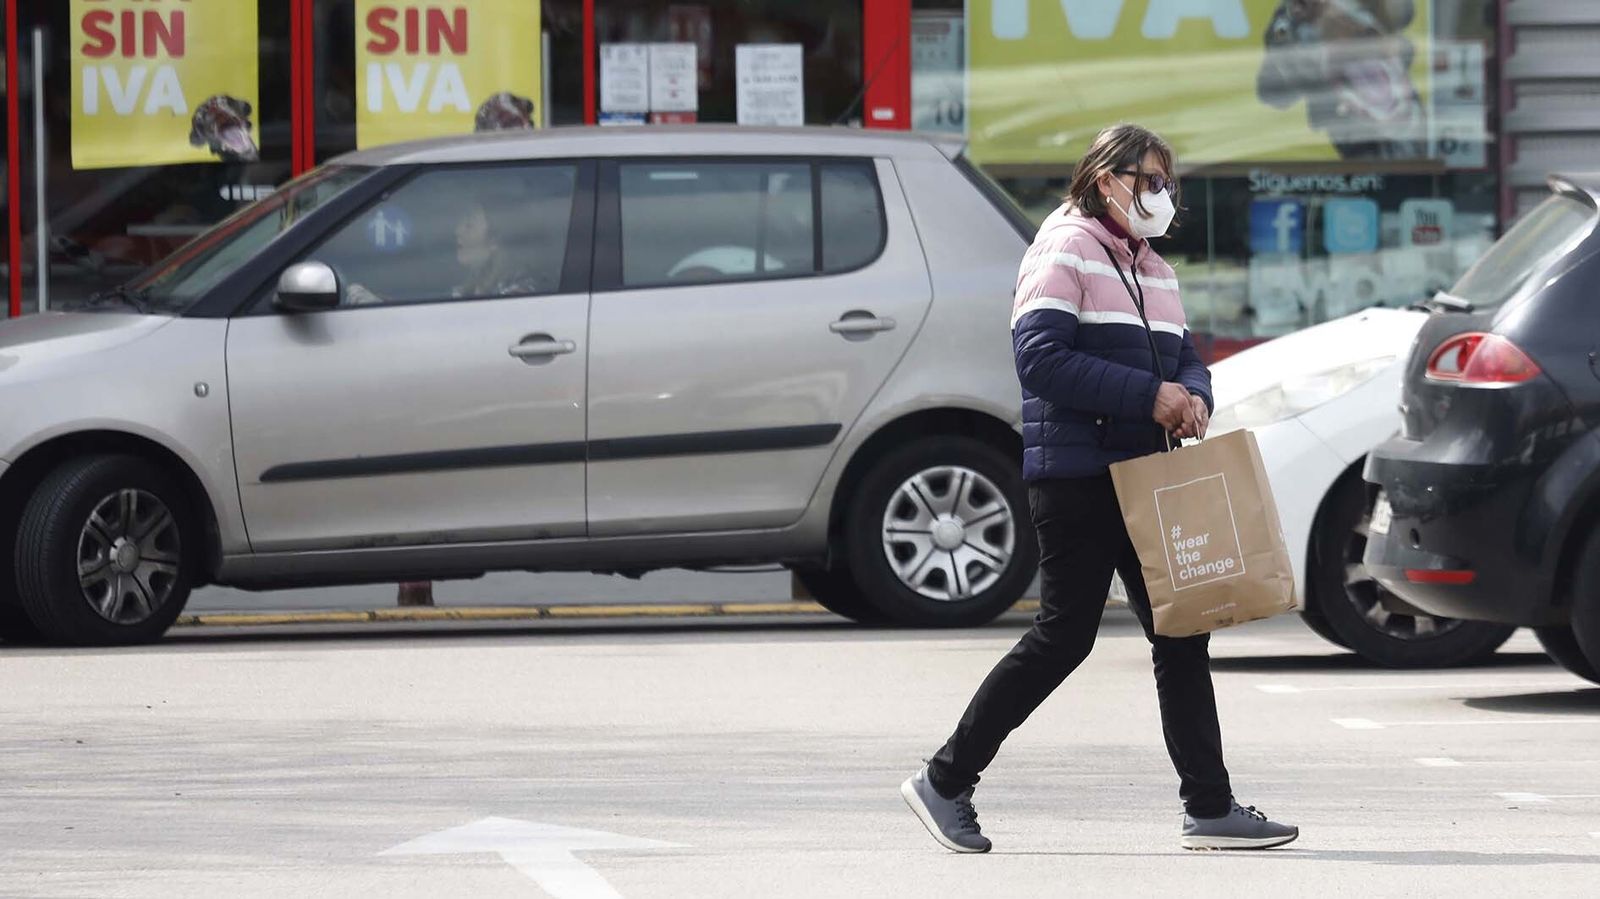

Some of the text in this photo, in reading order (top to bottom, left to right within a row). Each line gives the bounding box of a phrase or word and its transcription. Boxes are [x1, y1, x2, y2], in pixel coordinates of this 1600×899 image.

[81, 9, 186, 58] SIN
[366, 7, 468, 56] SIN
[82, 64, 189, 116] IVA
[367, 61, 472, 114] IVA
[1171, 525, 1182, 539] #
[1173, 532, 1210, 551] wear
[1175, 550, 1201, 566] the
[1179, 557, 1235, 580] change
